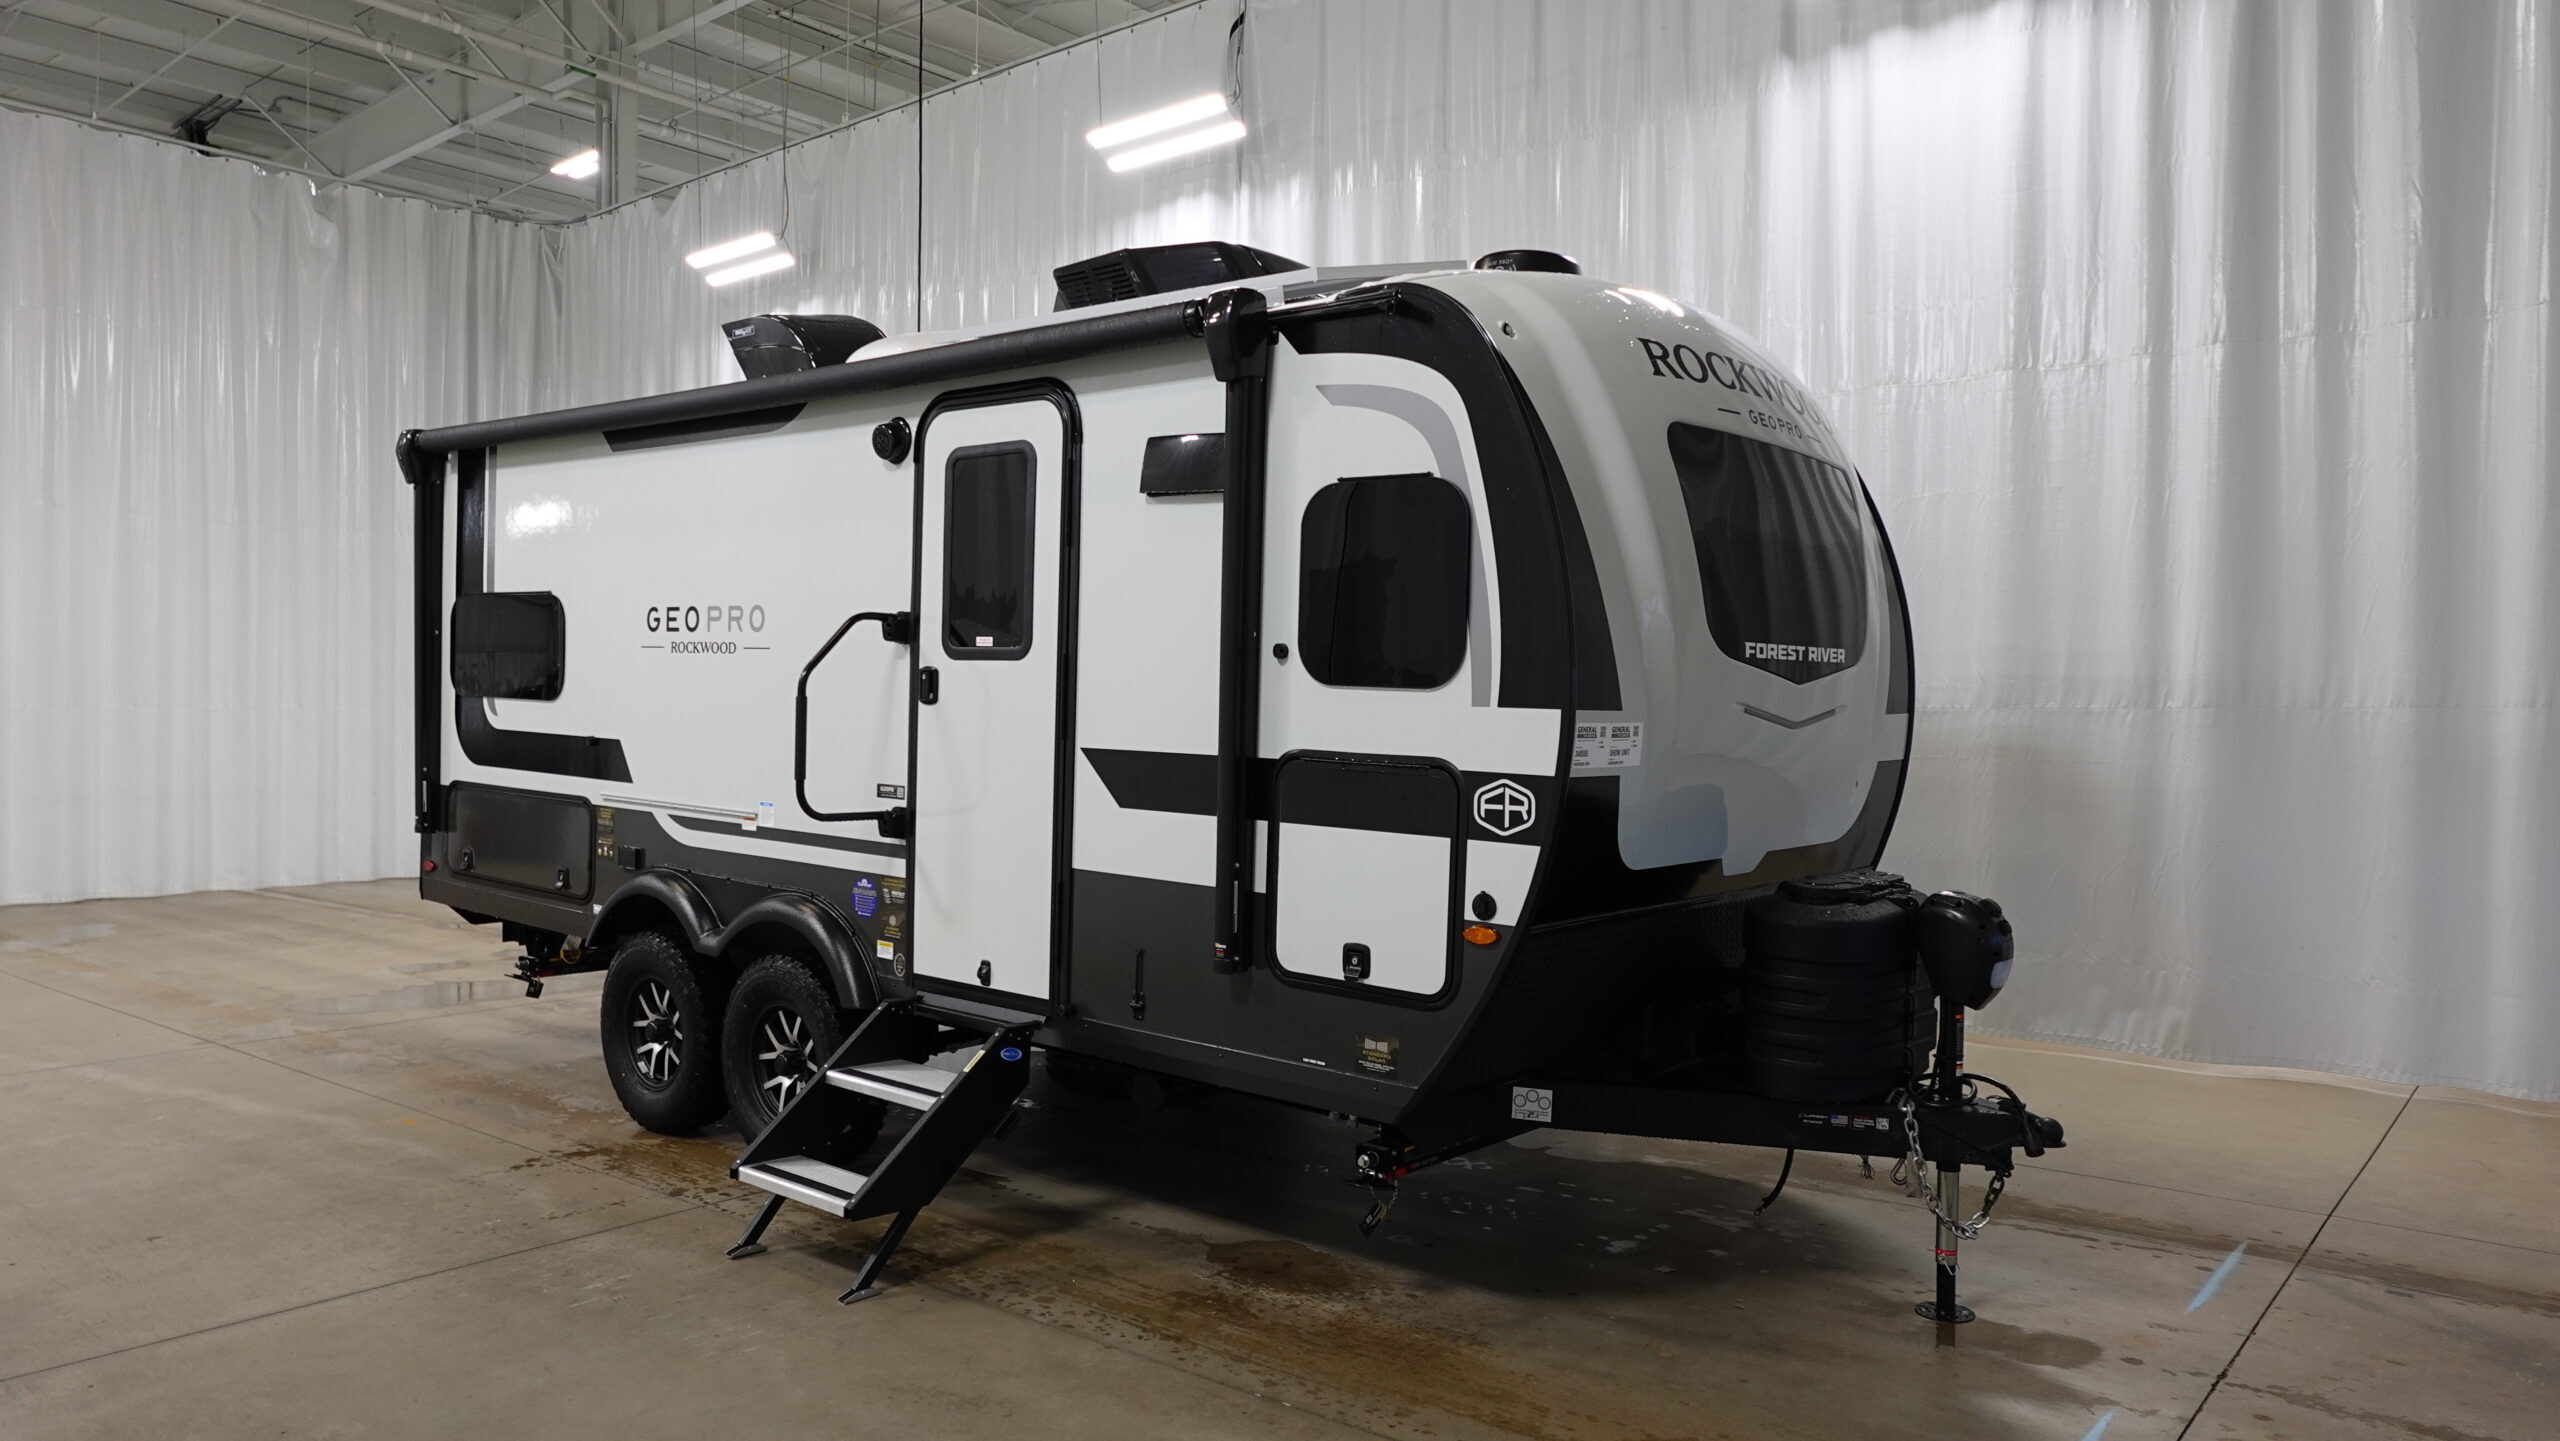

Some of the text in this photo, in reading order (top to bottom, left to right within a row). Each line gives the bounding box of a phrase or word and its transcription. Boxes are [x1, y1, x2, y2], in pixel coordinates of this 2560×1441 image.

[1748, 409, 1803, 440] GEOPRO
[670, 641, 737, 654] ROCKWOOD
[1745, 641, 1846, 663] FOREST RIVER
